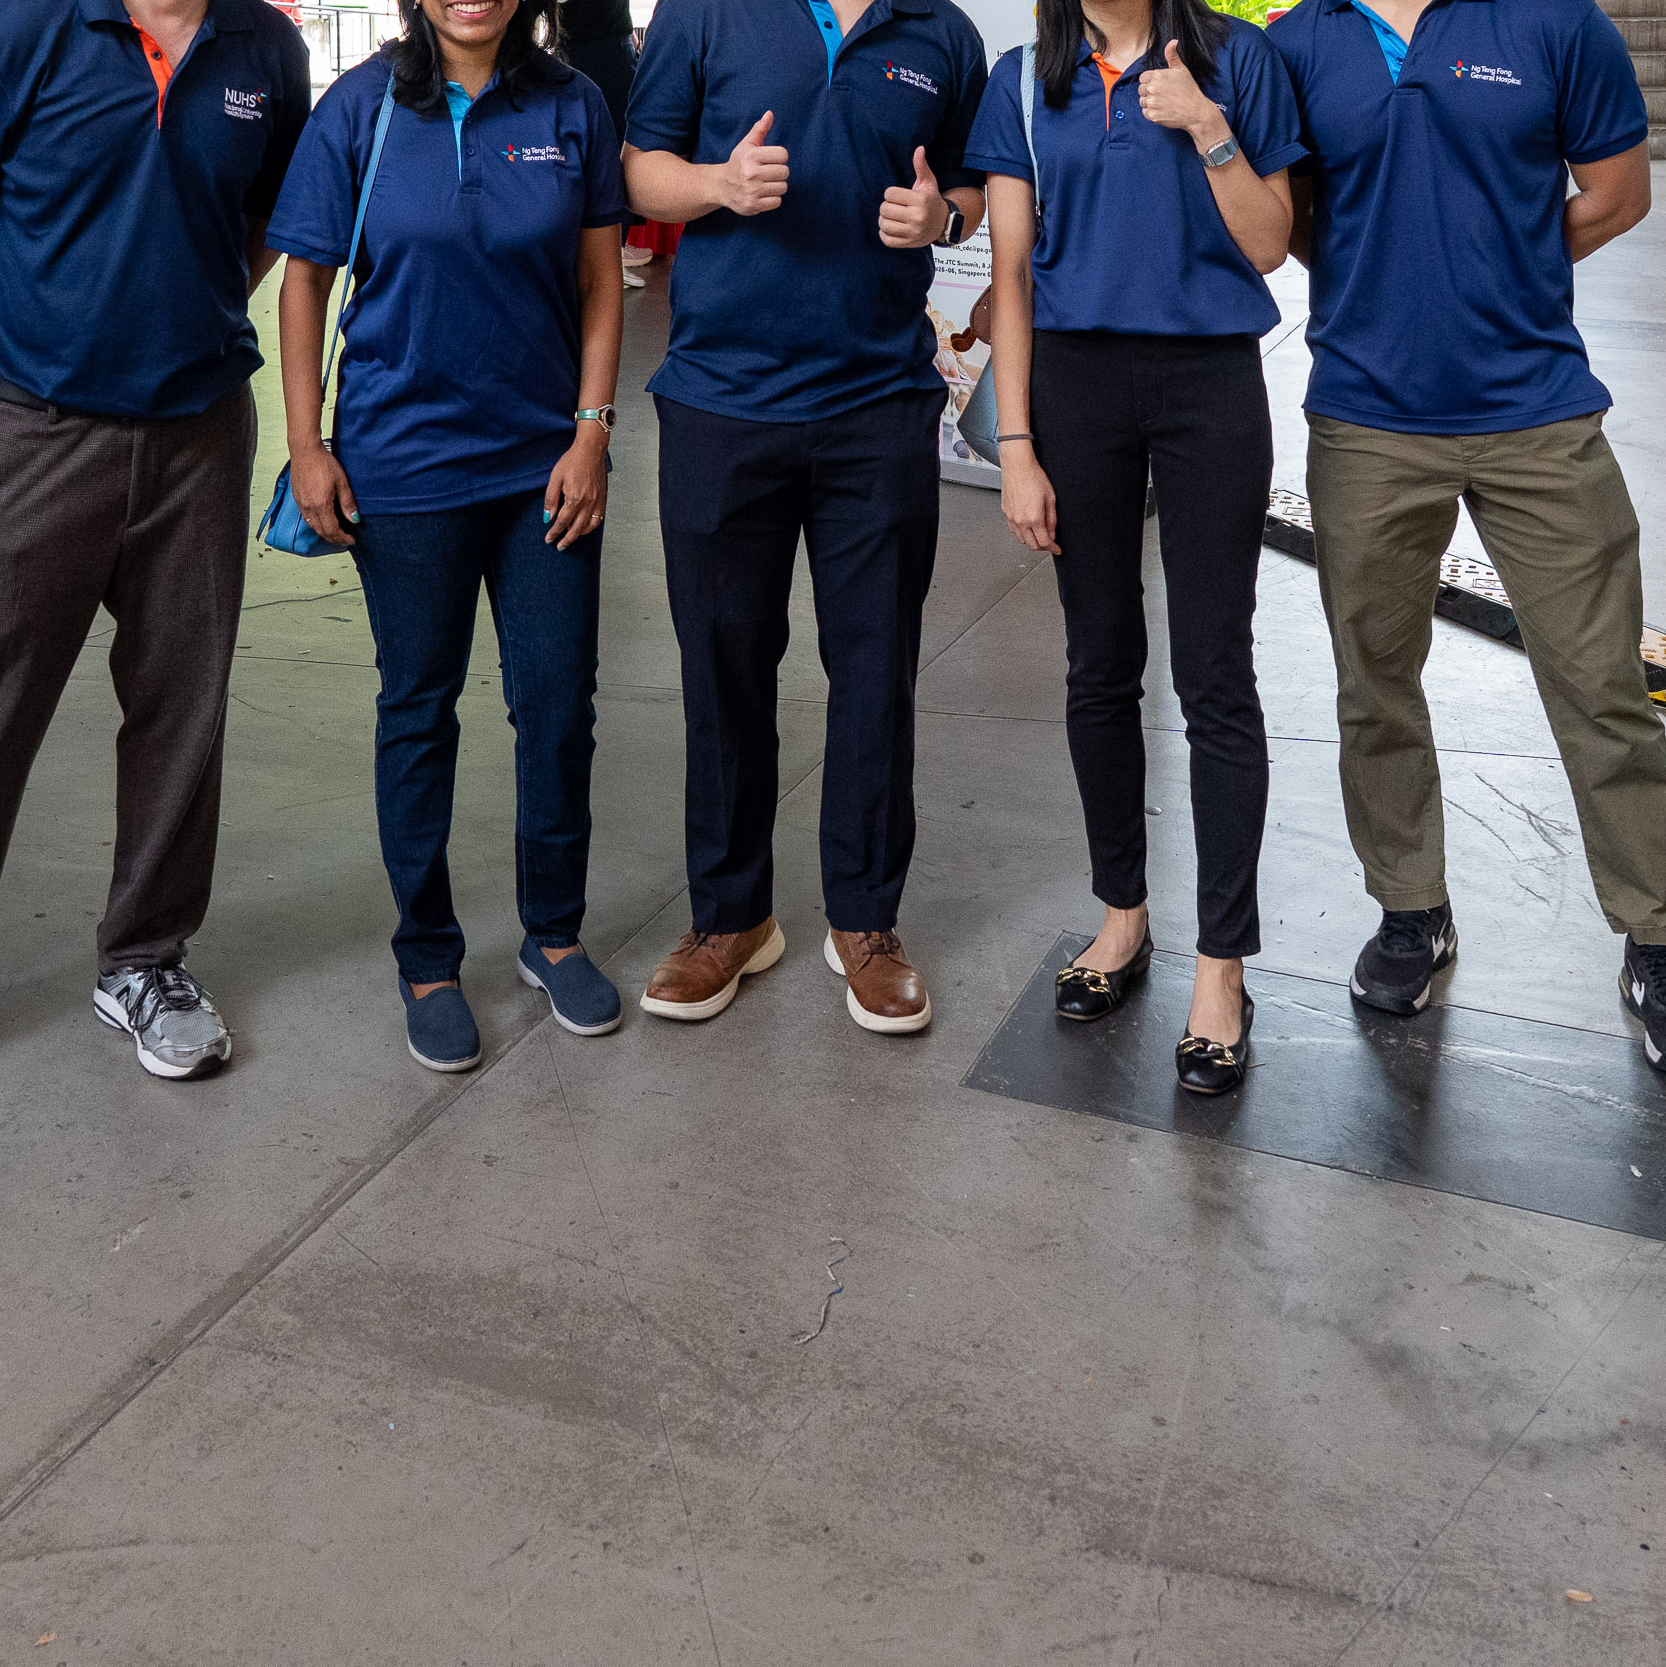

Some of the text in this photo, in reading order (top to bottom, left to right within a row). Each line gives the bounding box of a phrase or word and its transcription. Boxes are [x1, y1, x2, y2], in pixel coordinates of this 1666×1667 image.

[1471, 65, 1512, 77] Ng Teng Fong
[1471, 72, 1494, 81] General
[225, 88, 256, 107] NUHS
[531, 147, 545, 155] Teng
[958, 269, 985, 277] Singapore
